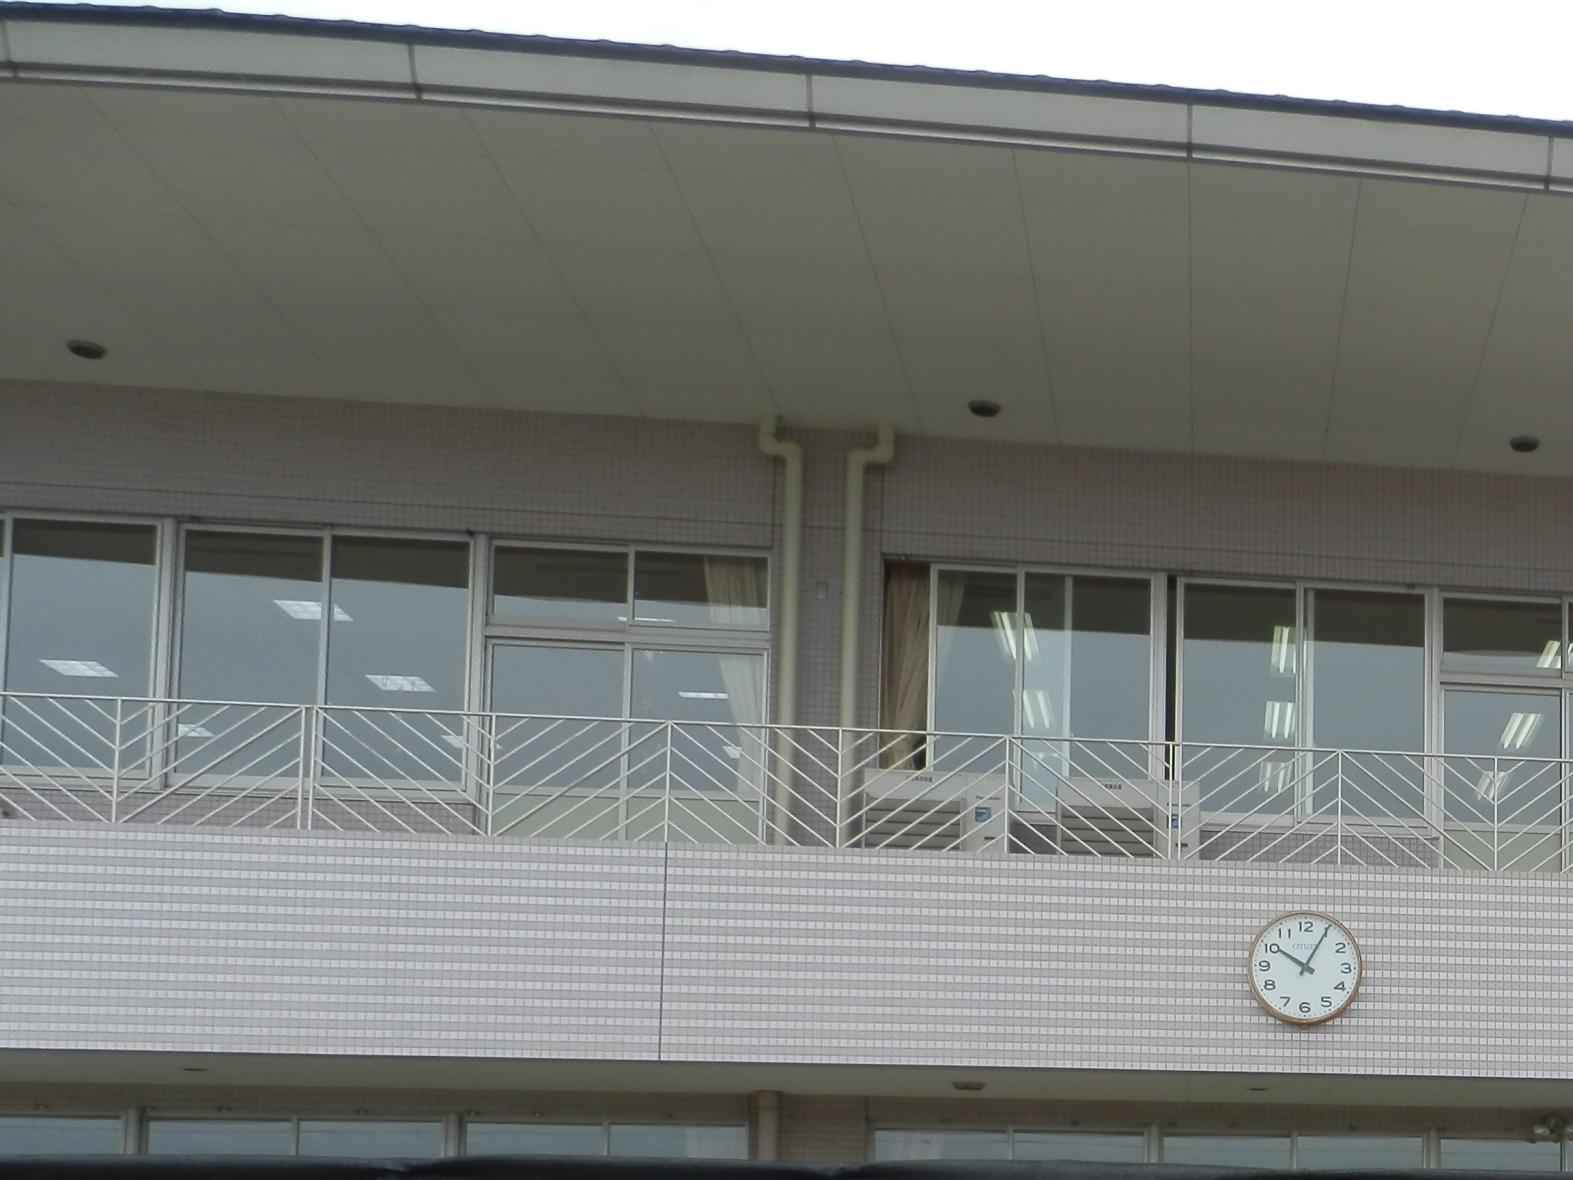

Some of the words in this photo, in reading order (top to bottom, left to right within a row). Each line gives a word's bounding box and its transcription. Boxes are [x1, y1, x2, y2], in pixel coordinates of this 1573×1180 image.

[1299, 921, 1314, 932] 12
[1278, 928, 1291, 939] 11
[1264, 943, 1280, 954] 10
[1335, 942, 1346, 954] 2
[1258, 960, 1271, 972] 9
[1340, 962, 1352, 974] 3
[1263, 979, 1276, 991] 8
[1333, 981, 1346, 992] 4
[1280, 996, 1291, 1007] 7
[1320, 996, 1332, 1007] 5
[1299, 1002, 1311, 1013] 6
